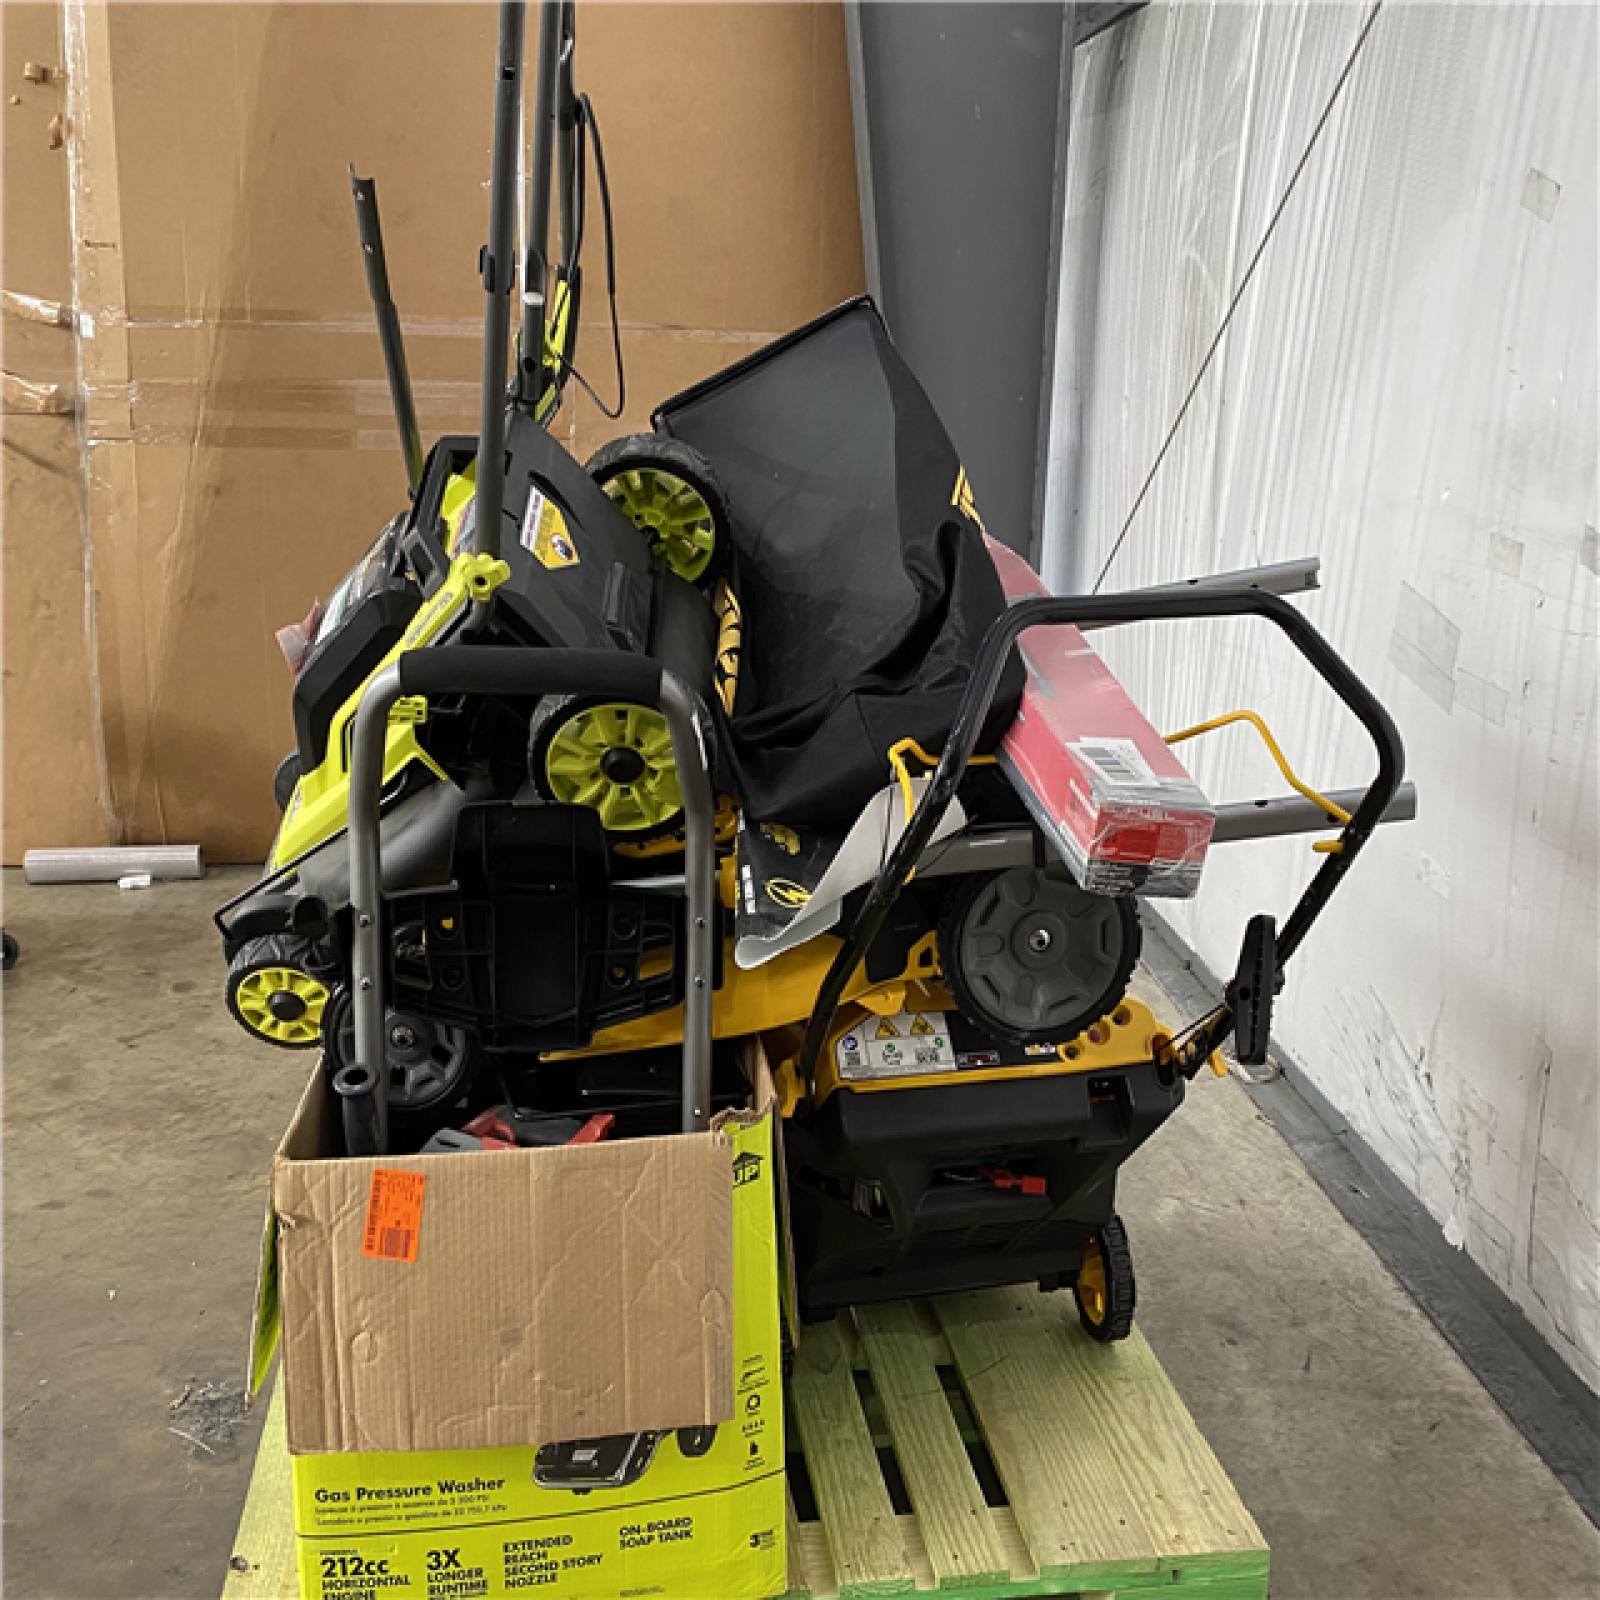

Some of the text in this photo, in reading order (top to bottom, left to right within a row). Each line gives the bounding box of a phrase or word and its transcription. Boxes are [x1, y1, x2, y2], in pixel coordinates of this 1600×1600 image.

[314, 1476, 506, 1503] Gas Pressure Washer
[620, 1517, 693, 1536] ON-BOARD
[503, 1535, 573, 1553] EXTENDED
[620, 1529, 693, 1550] SOAP TANK
[321, 1556, 390, 1577] 212cc
[427, 1547, 461, 1571] 3X
[504, 1550, 548, 1566] REACH
[504, 1552, 603, 1577] SECOND STORY
[322, 1574, 411, 1590] HORIZONTAL
[427, 1568, 483, 1583] LONGER
[504, 1572, 558, 1590] NOZZLE
[427, 1579, 488, 1595] RUNTIME
